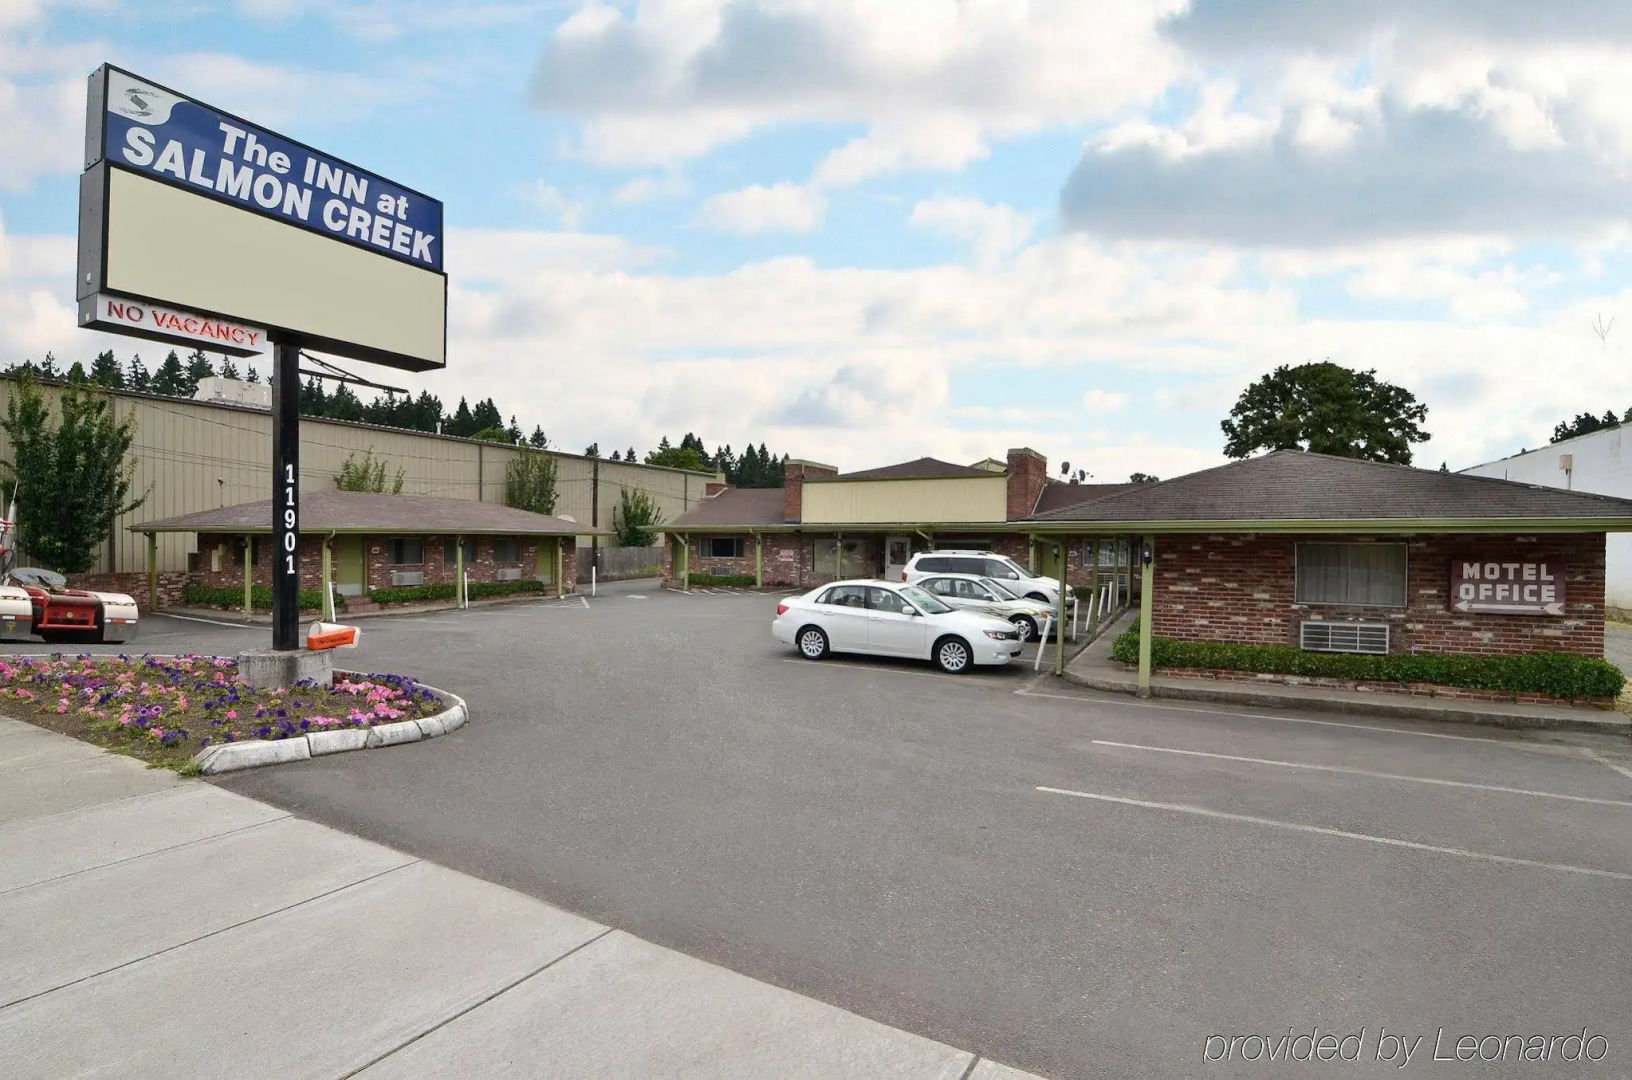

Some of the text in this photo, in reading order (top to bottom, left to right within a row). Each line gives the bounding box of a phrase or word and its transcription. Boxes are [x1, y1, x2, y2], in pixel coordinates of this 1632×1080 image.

[122, 126, 436, 264] SALMON CREEK
[219, 121, 409, 221] The INN at
[107, 300, 259, 345] NO VACANCY
[284, 463, 296, 575] 11901
[1459, 583, 1556, 602] OFFICE
[1462, 563, 1554, 581] MOTEL
